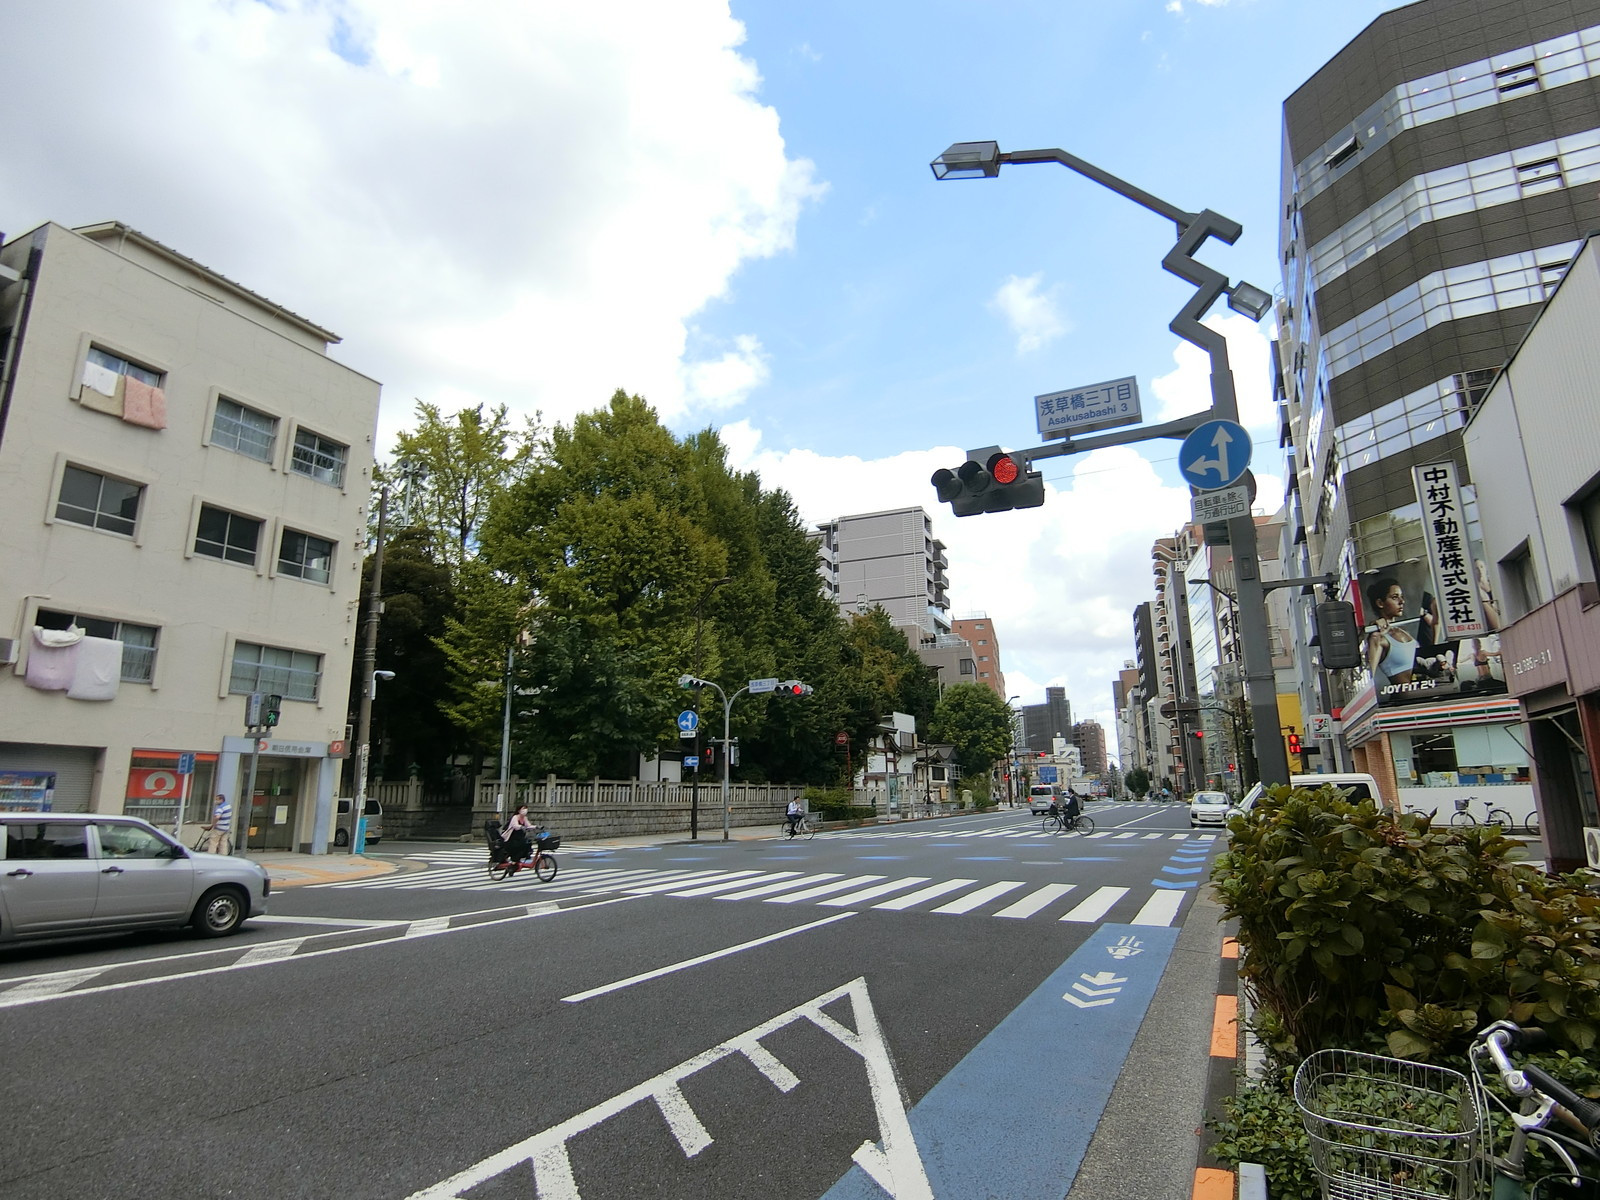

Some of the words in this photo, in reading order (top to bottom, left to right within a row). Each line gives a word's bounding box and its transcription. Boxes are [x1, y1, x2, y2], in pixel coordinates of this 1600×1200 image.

[1040, 383, 1131, 417] 浅草橋三丁目
[1048, 404, 1117, 427] Asakusabashi
[1120, 402, 1128, 412] 3
[1195, 491, 1243, 510] 自転車を除く
[1195, 502, 1245, 520] 一方通行出口
[1423, 467, 1476, 624] 中村不動産株式会社
